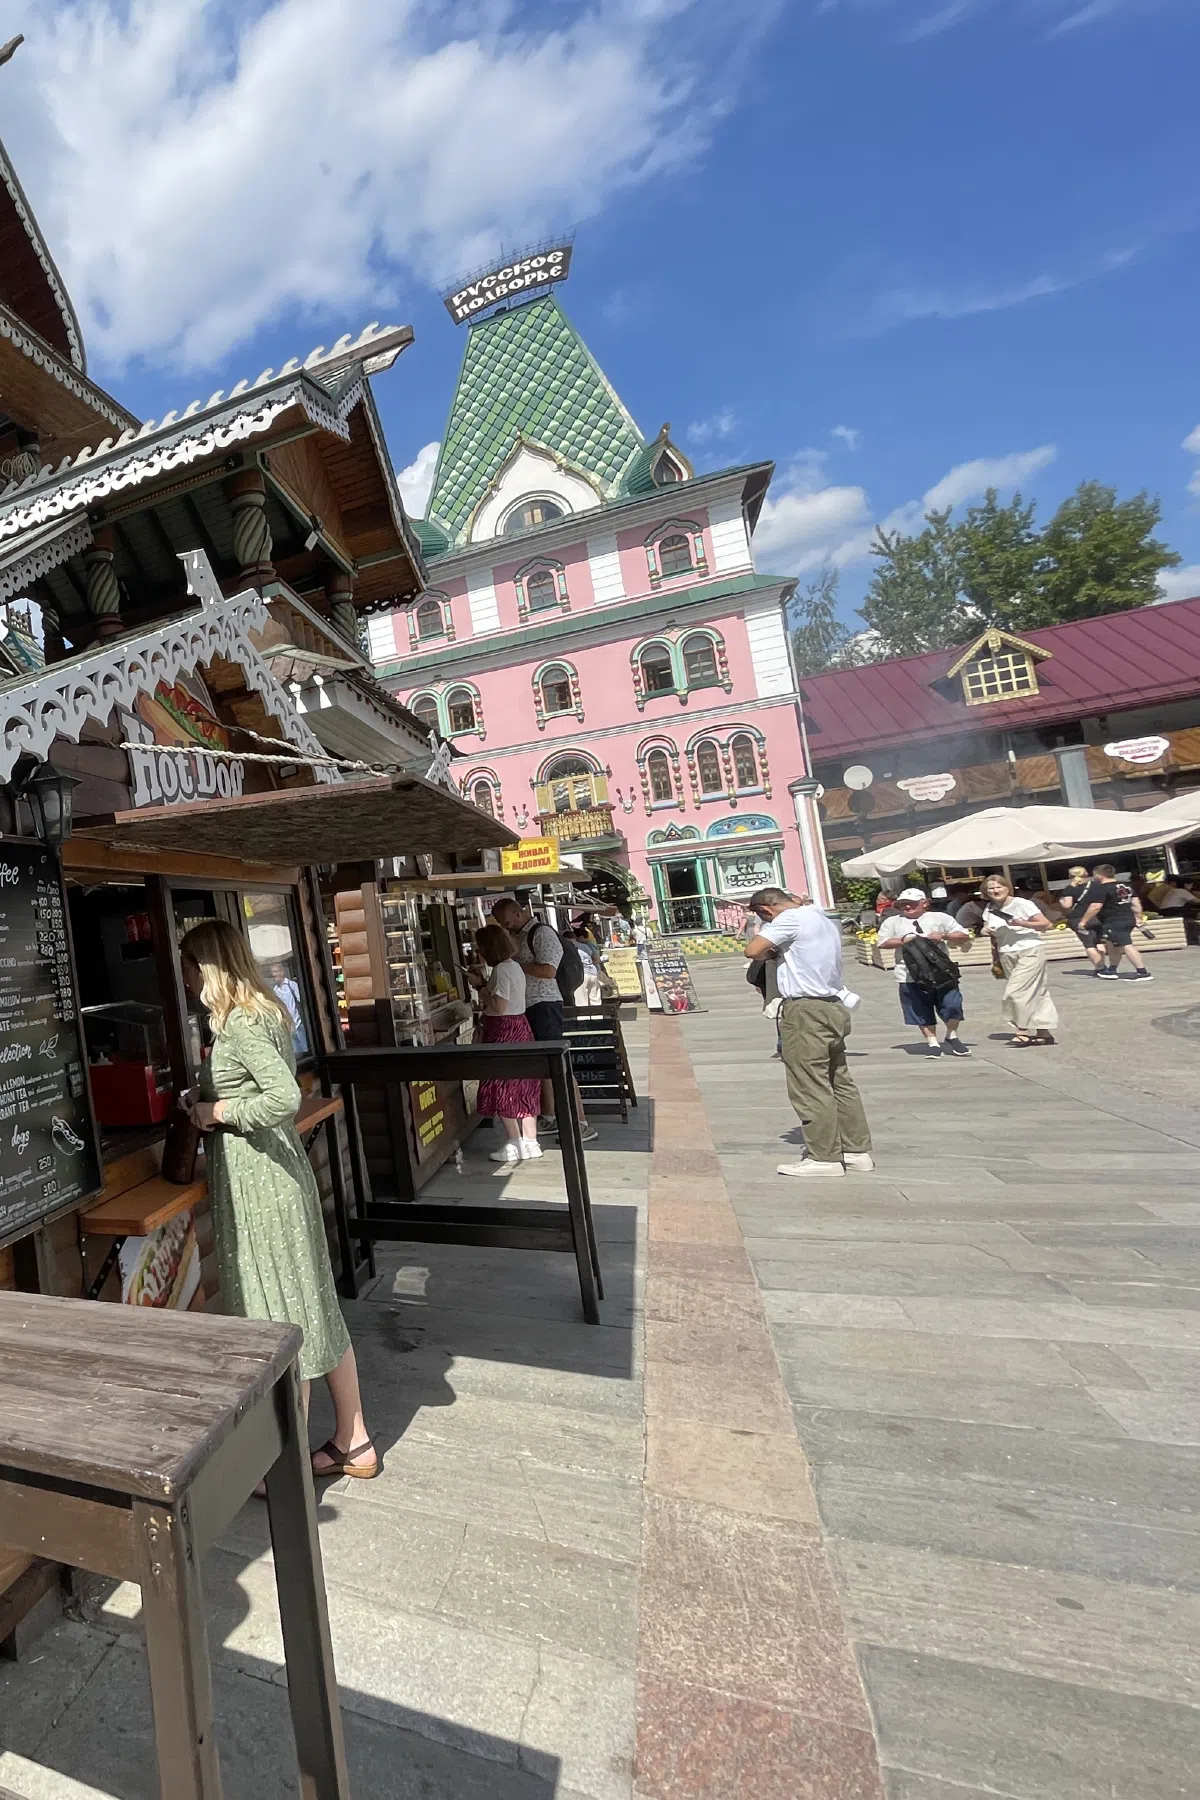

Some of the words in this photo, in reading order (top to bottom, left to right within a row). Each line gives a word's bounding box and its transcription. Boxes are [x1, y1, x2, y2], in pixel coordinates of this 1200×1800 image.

[452, 251, 564, 307] РУССКОЕ
[455, 265, 562, 319] ПОДВОРЬЕ
[512, 857, 551, 871] МЕДОВУХА
[39, 931, 55, 942] 220
[6, 1075, 26, 1089] LEMON
[16, 1088, 28, 1099] TEA
[18, 1100, 30, 1112] TEA
[11, 1124, 31, 1155] dogs
[38, 1155, 51, 1170] 250
